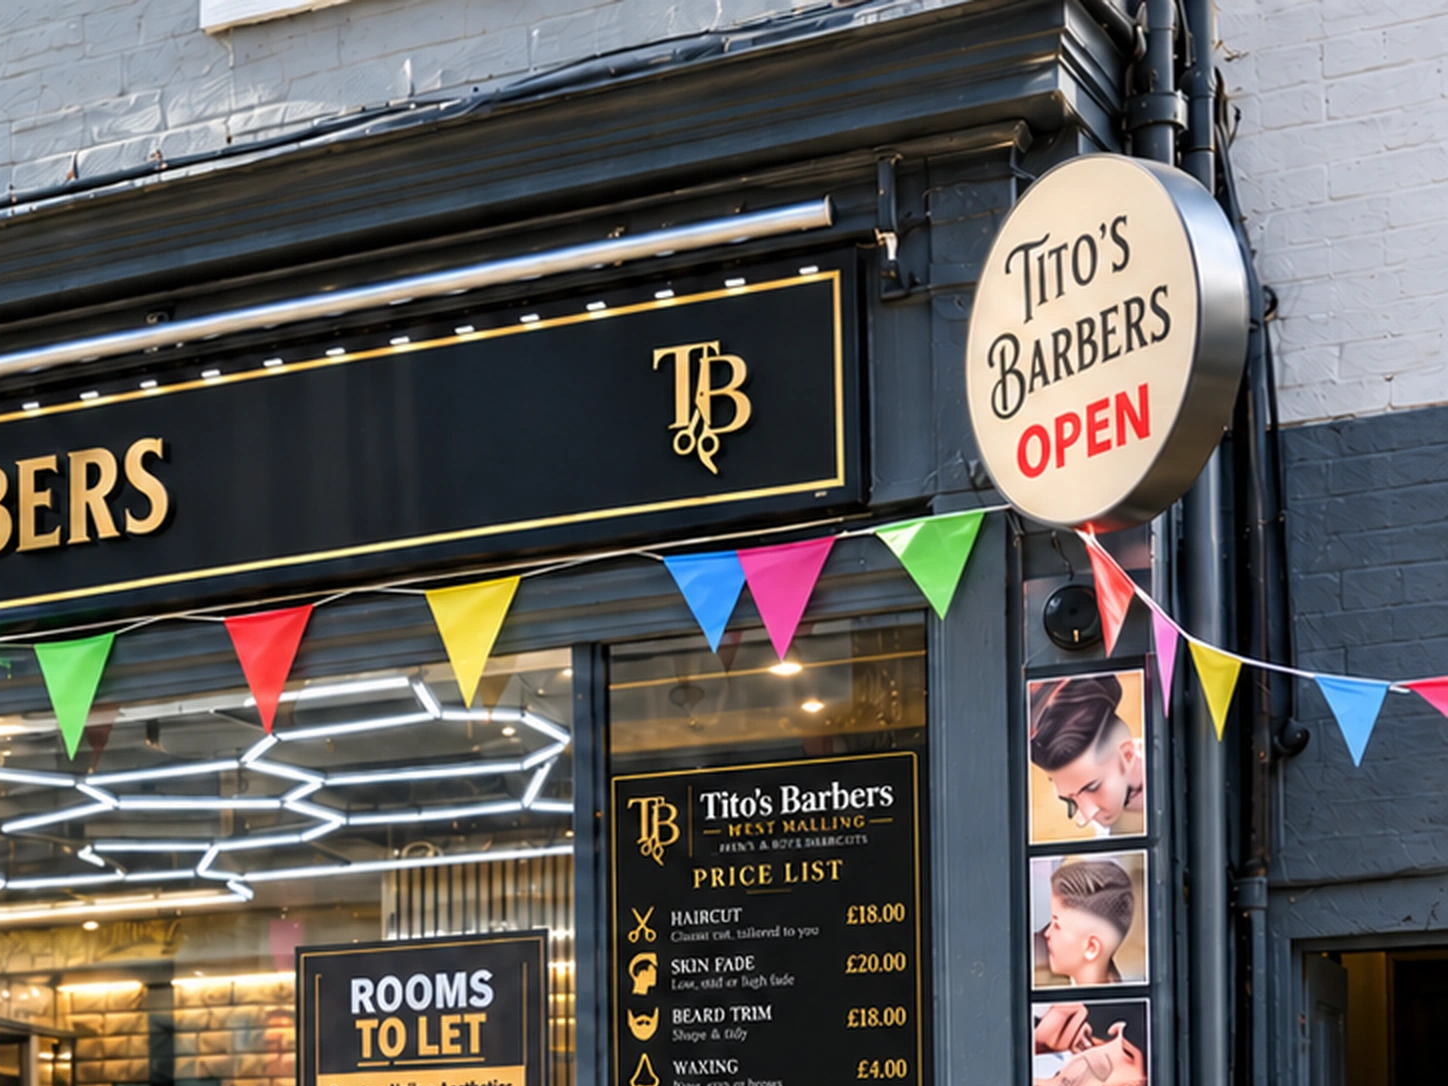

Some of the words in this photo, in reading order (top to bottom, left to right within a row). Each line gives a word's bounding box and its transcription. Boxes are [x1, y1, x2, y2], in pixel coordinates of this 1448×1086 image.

[1005, 214, 1131, 325] TITO'S
[987, 284, 1171, 420] BARBERS
[1016, 382, 1151, 479] OPEN
[700, 787, 773, 821] Tito's
[780, 781, 894, 815] Barbers
[693, 864, 773, 889] PRICE
[784, 859, 843, 883] LIST
[671, 907, 743, 926] HAIRCUT
[846, 903, 905, 925] £18.00
[797, 927, 819, 939] you
[671, 957, 709, 975] SKIN
[715, 955, 755, 972] FADE
[845, 952, 906, 974] £20.00
[351, 968, 495, 1015] ROOMS
[672, 1007, 725, 1024] BEARD
[729, 1005, 772, 1022] TRIM
[846, 1006, 906, 1028] £18.00
[354, 1018, 408, 1060] TO
[417, 1013, 488, 1057] LET
[673, 1058, 739, 1075] WAXING
[857, 1058, 907, 1079] £4.00
